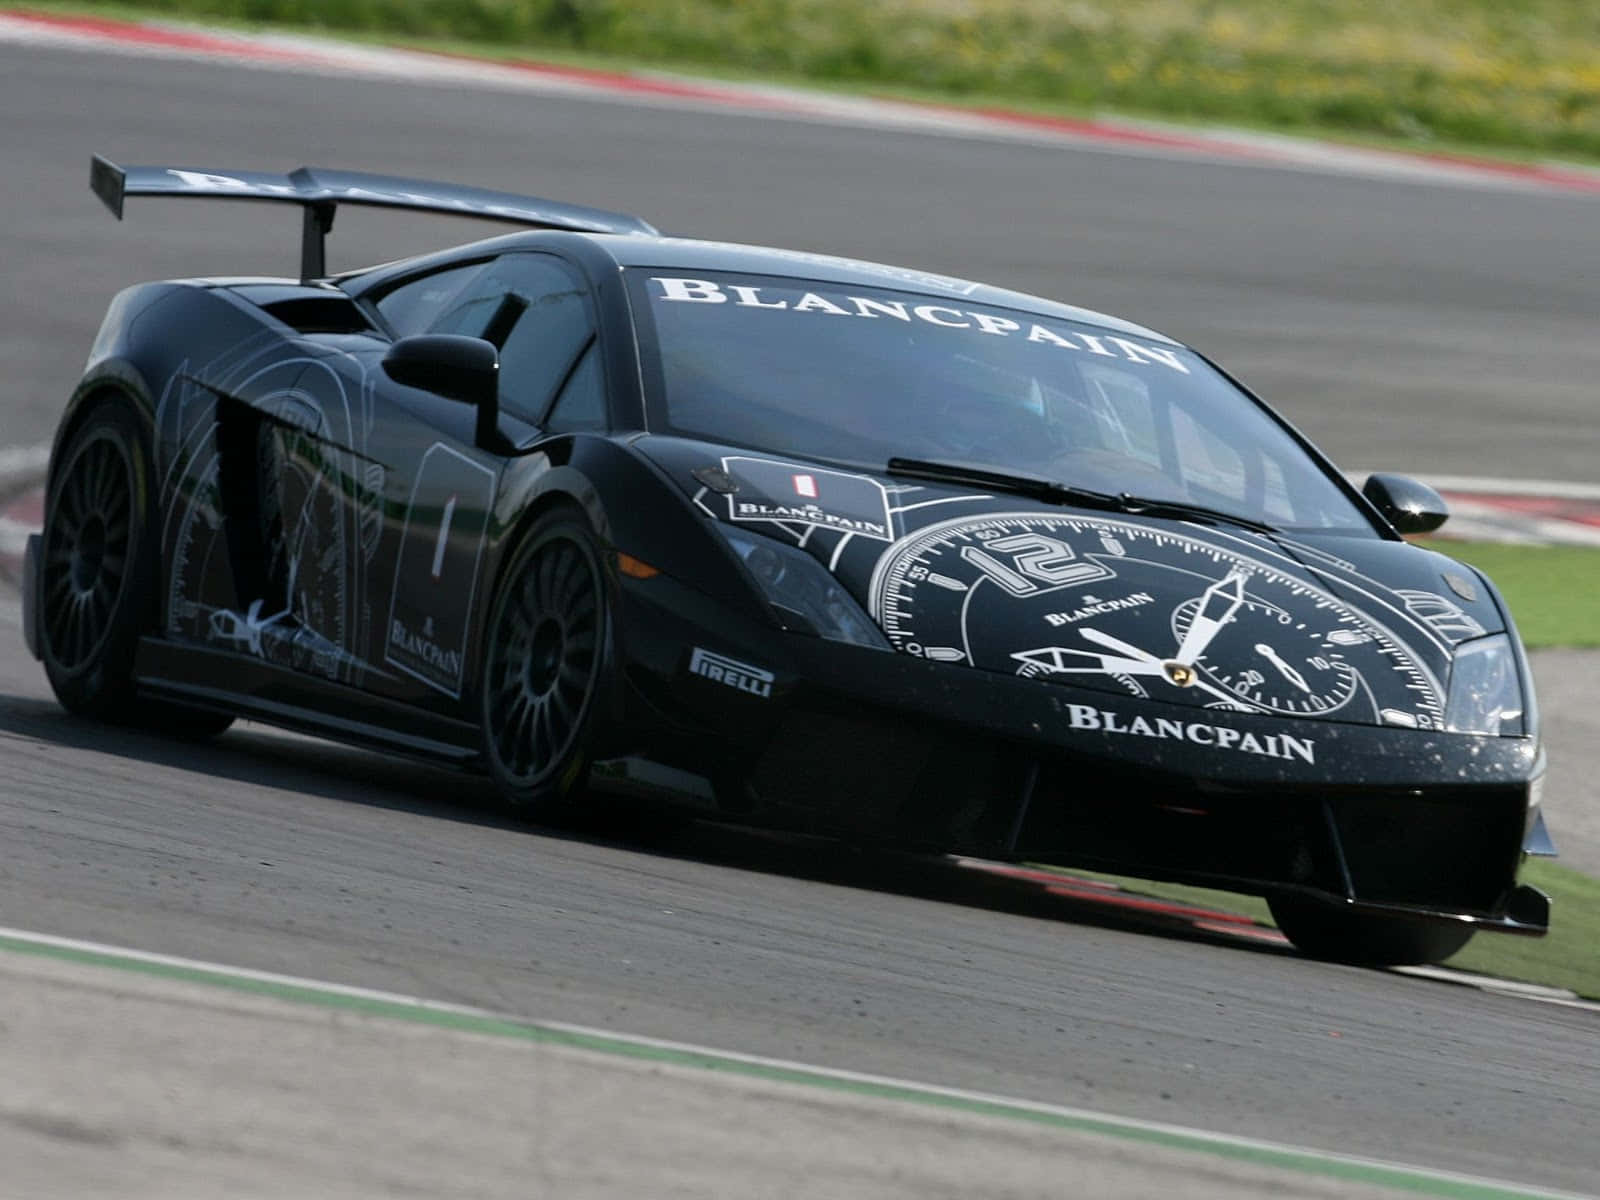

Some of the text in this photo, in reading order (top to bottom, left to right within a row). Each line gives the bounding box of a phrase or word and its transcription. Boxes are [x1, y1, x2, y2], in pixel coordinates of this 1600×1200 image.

[649, 277, 1190, 373] BLANCPAIN
[738, 503, 884, 533] BLANCPAIN
[961, 533, 1117, 598] 12
[1044, 592, 1154, 627] BLANCPAIN
[689, 647, 775, 697] PIRELLI
[1067, 704, 1315, 764] BLANCPAIN
